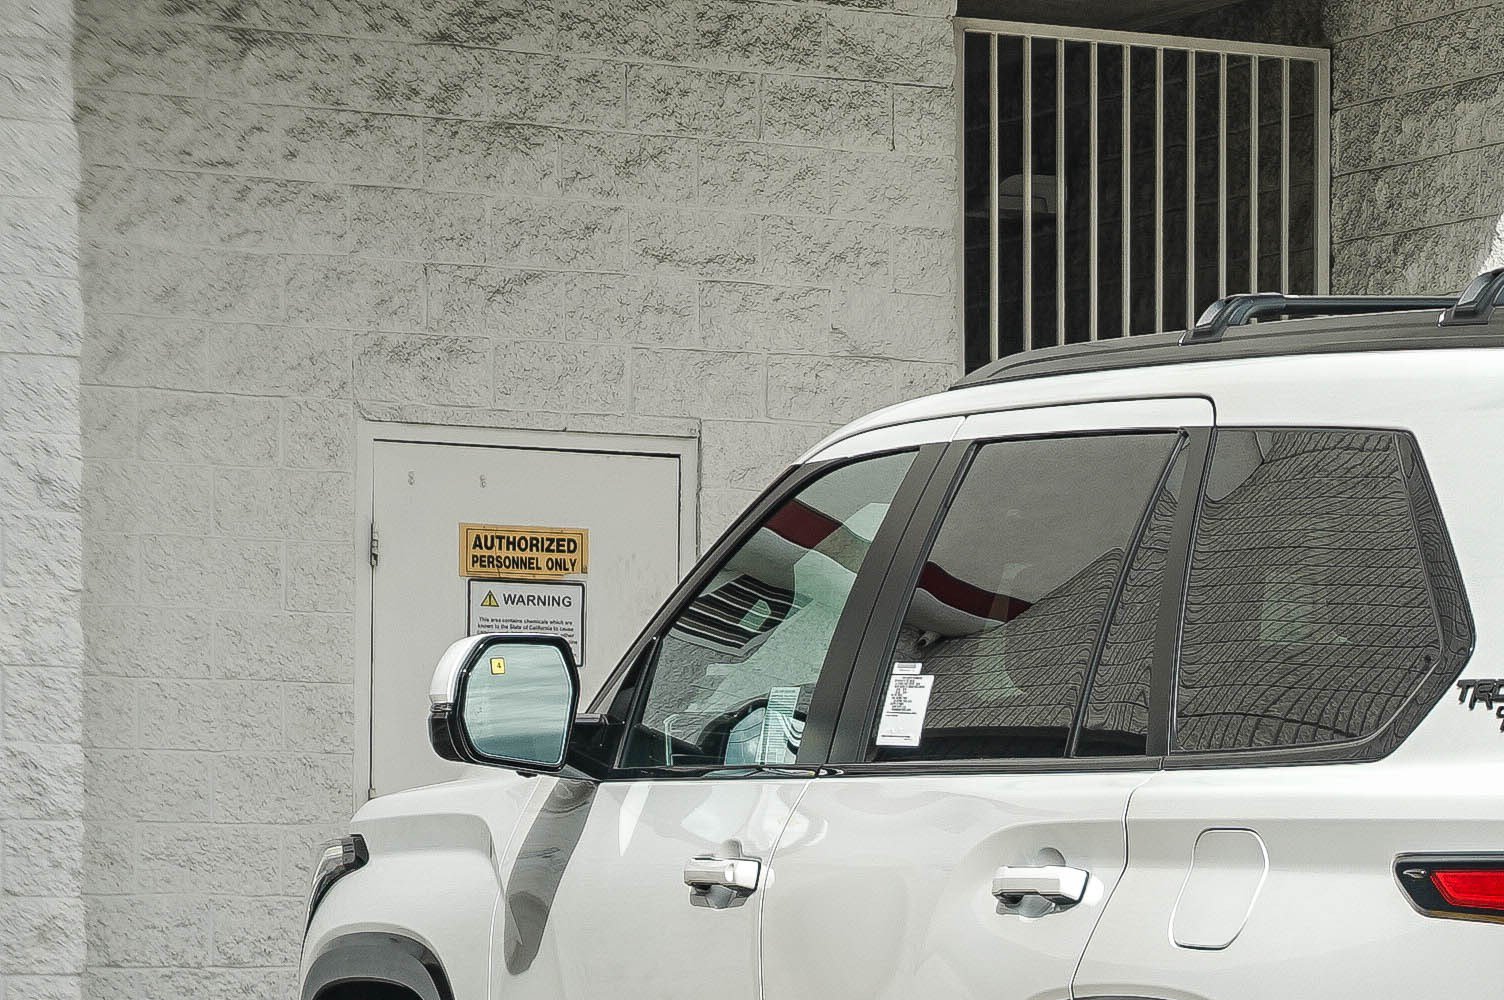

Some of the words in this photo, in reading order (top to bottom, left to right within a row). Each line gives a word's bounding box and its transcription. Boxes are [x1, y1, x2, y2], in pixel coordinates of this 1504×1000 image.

[472, 534, 577, 554] AUTHORIZED
[472, 554, 542, 571] PERSONNEL
[546, 557, 577, 572] ONLY
[503, 593, 572, 607] WARNING
